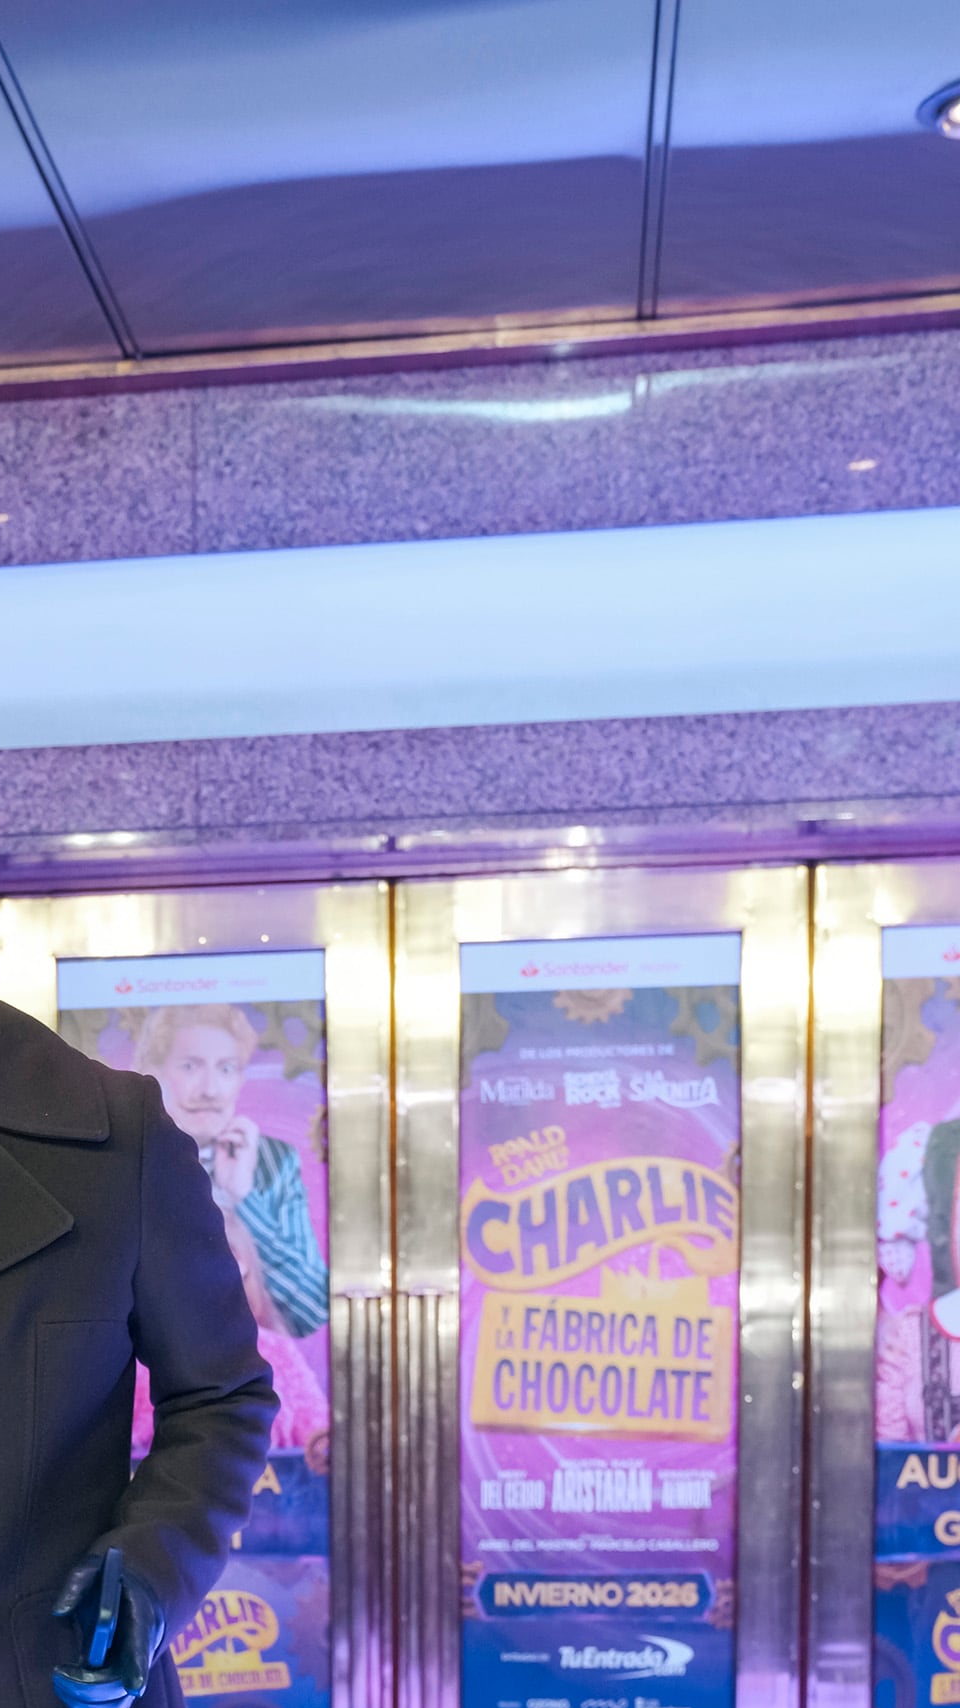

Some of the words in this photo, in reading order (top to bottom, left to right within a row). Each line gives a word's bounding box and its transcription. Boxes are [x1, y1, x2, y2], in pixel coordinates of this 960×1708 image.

[480, 1079, 556, 1104] Matilda
[488, 1125, 566, 1166] ROALD
[465, 1165, 736, 1277] CHARLIE
[522, 1299, 659, 1356] FÁBRICA
[673, 1317, 714, 1361] DE
[492, 1358, 713, 1422] CHOCOLATE
[895, 1453, 960, 1489] AU
[494, 1581, 624, 1608] INVIERNO
[626, 1581, 700, 1608] 2026
[558, 1646, 664, 1669] TuEntrada
